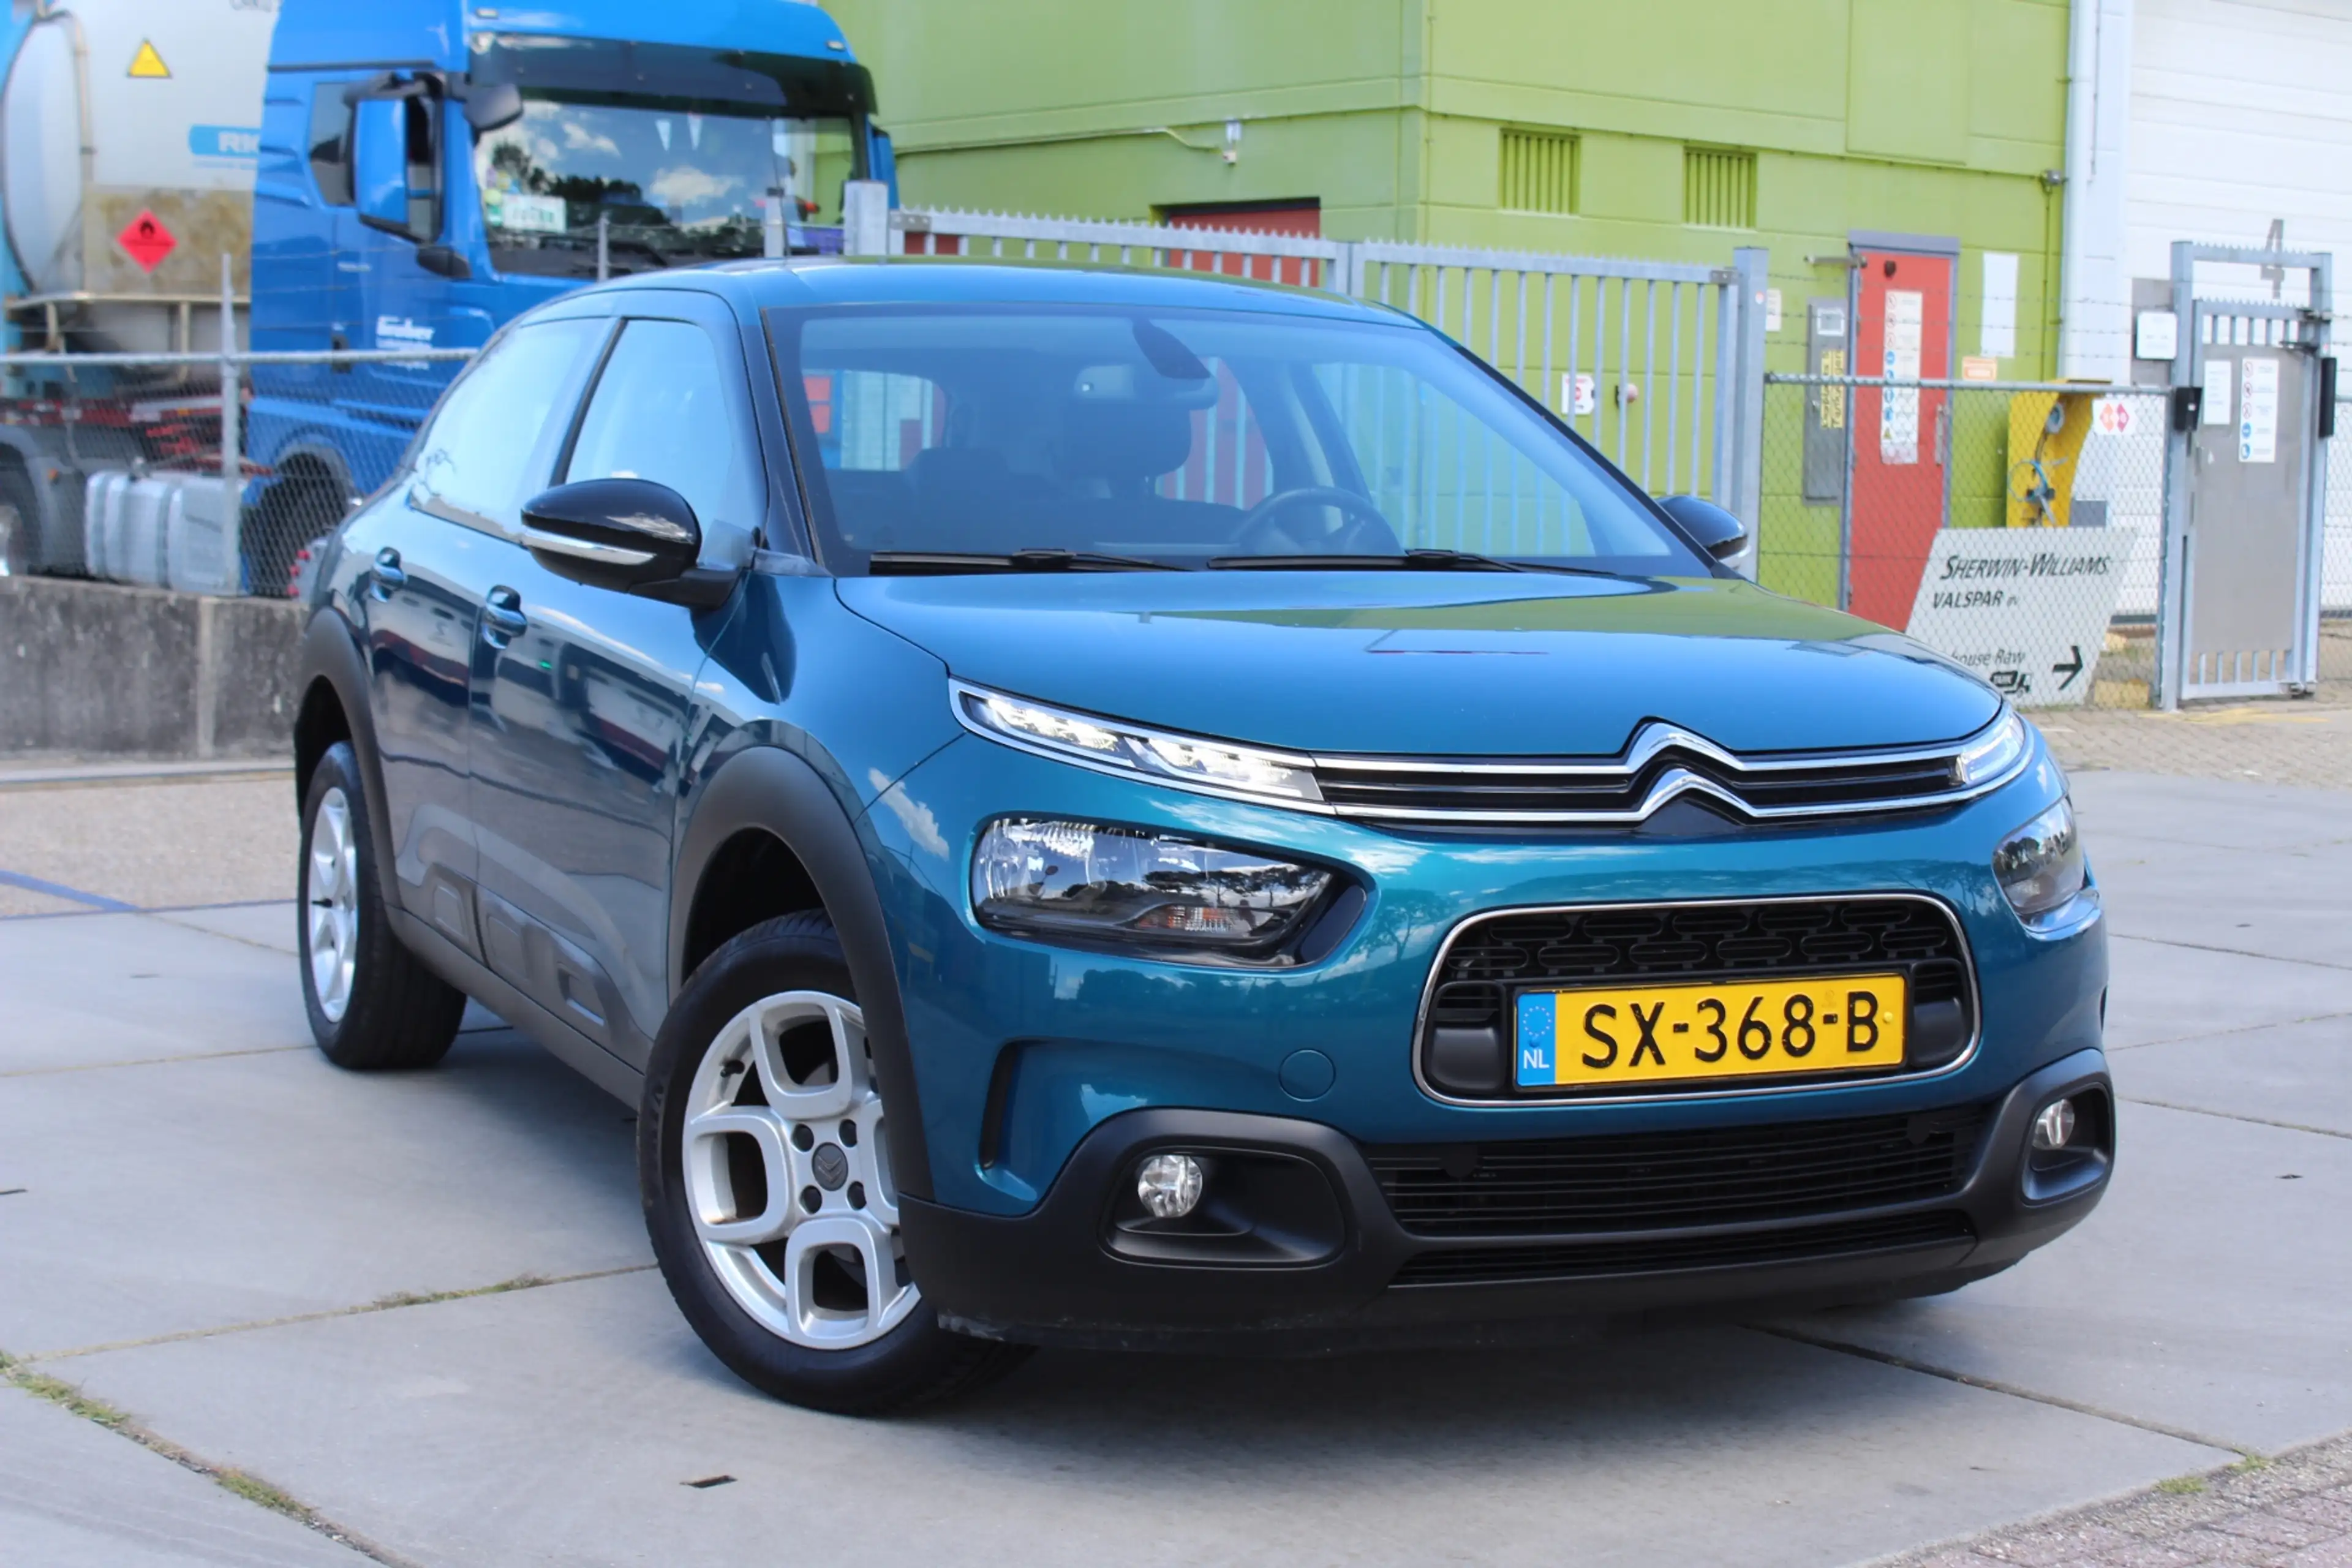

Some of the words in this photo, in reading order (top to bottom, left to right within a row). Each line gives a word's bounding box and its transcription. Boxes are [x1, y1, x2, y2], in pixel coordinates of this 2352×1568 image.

[2260, 218, 2286, 300] 4
[1932, 590, 2003, 609] VALSPAR
[1994, 649, 2026, 665] Raw
[1581, 990, 1879, 1069] SX-368-B
[1523, 1049, 1549, 1070] NL
